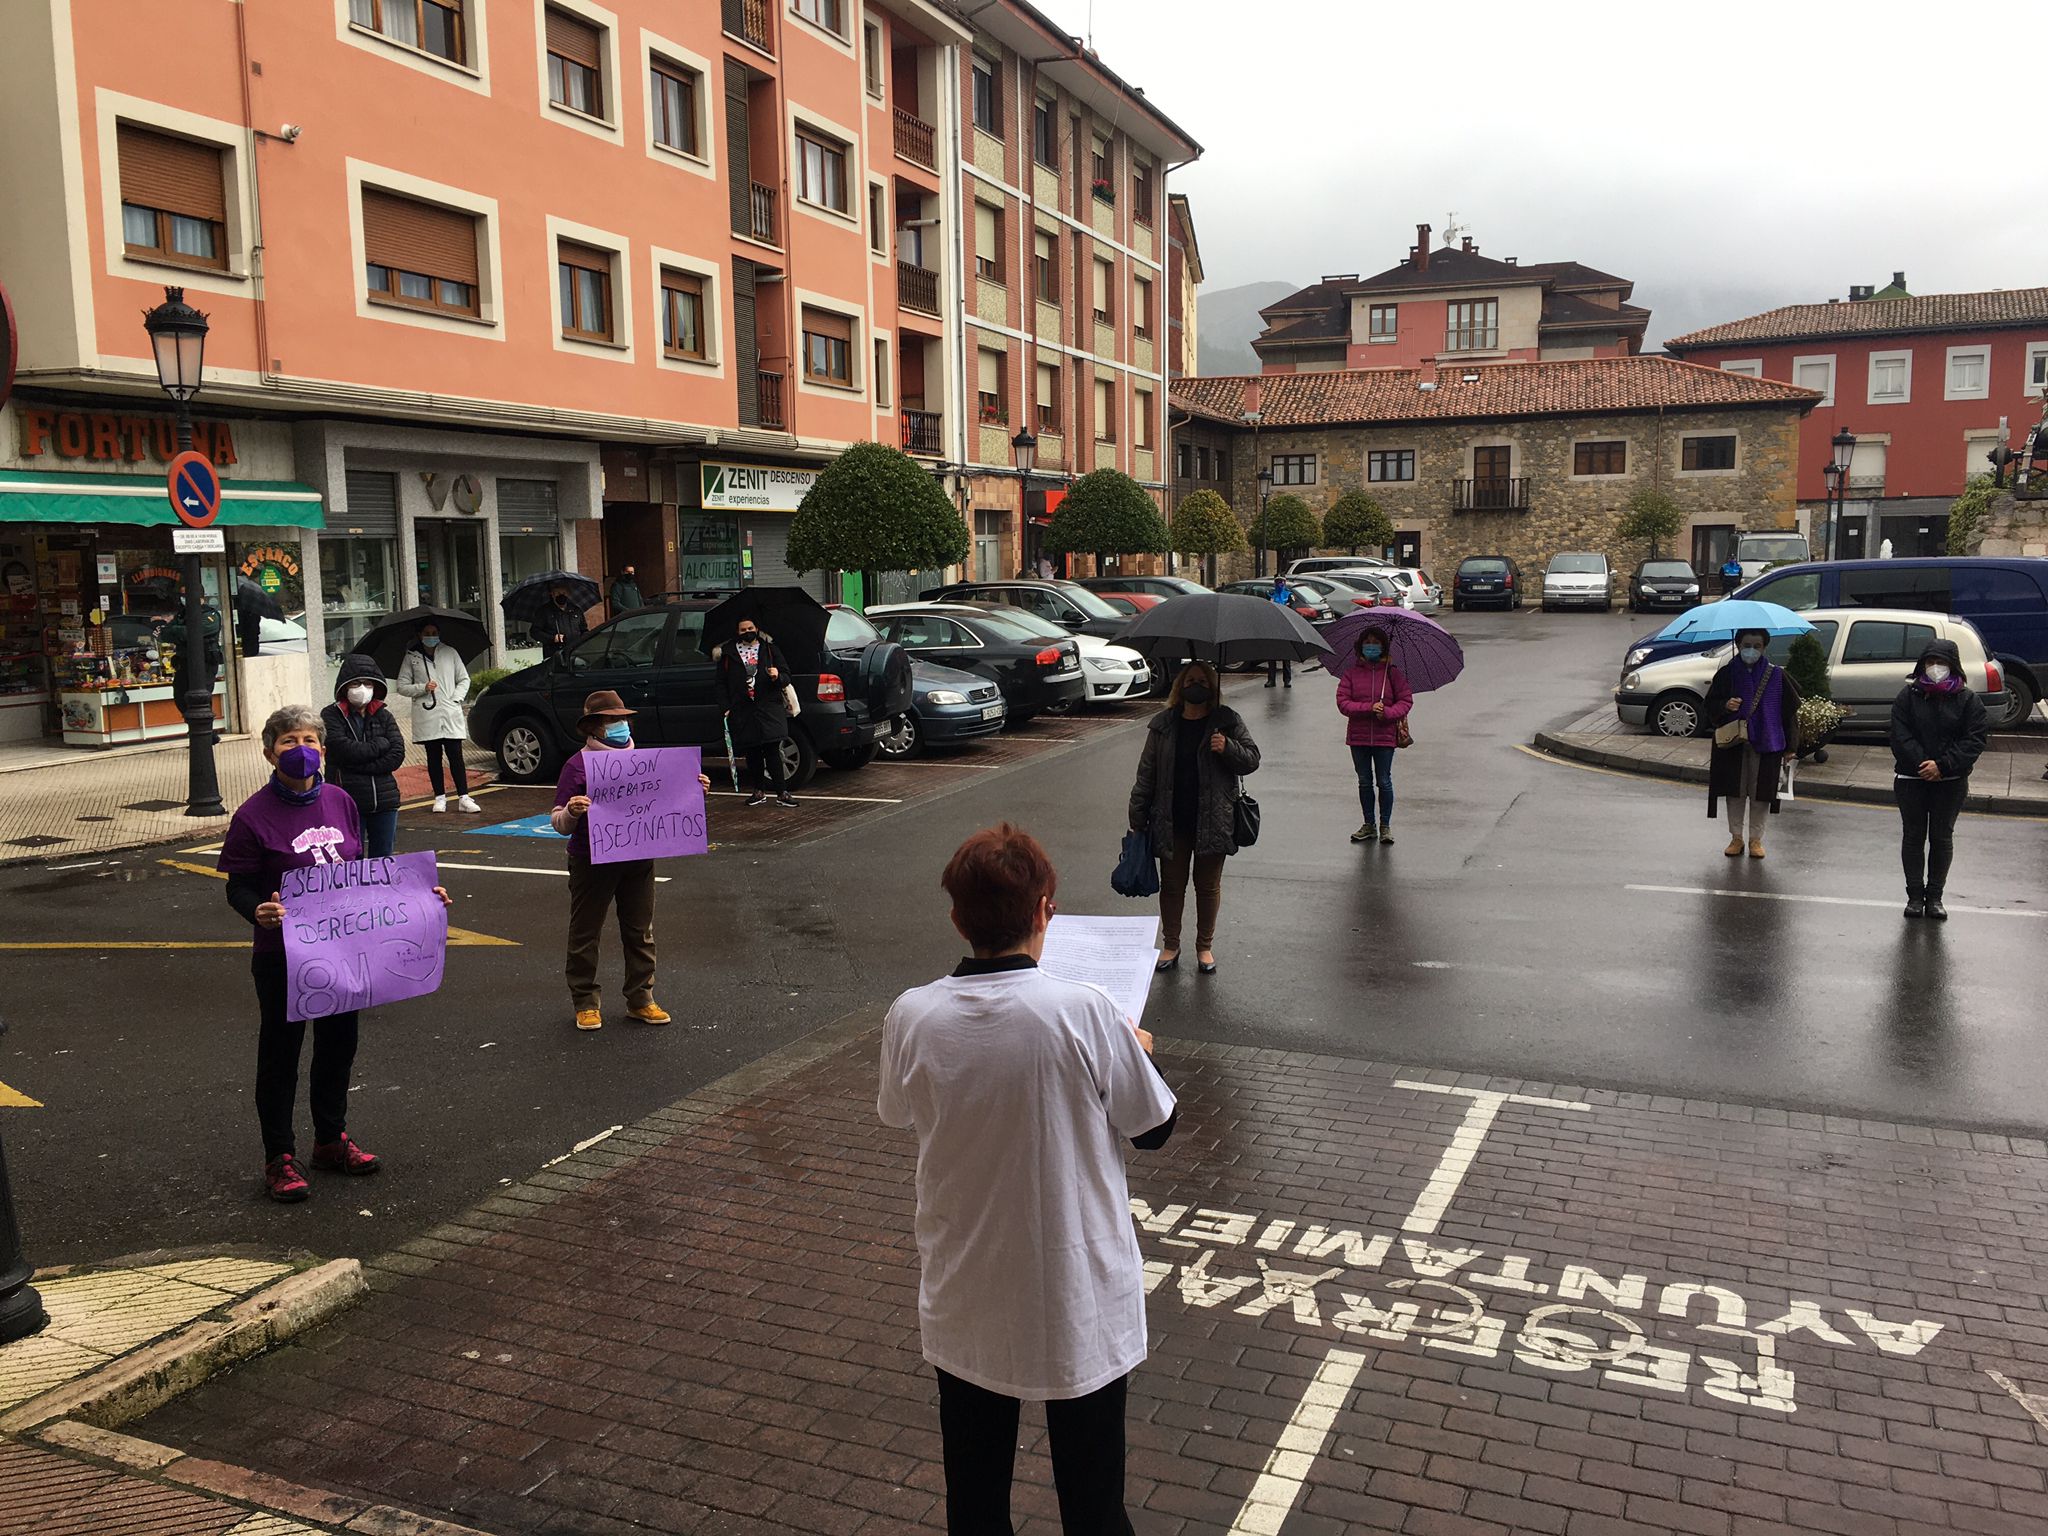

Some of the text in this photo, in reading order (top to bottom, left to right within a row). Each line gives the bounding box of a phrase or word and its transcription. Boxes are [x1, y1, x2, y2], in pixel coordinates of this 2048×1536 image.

[24, 409, 238, 465] FORTUNA
[728, 467, 768, 490] ZENIT
[770, 470, 811, 485] DESCENSO
[728, 494, 770, 506] experiencias
[241, 547, 299, 576] ESTANCO
[684, 561, 738, 580] ALQUILER
[592, 749, 662, 782] NO SON
[625, 799, 657, 817] SON
[279, 856, 395, 902] ESENCIALES
[294, 902, 410, 945] DERECHOS
[296, 952, 373, 1021] 8M
[1129, 1198, 1945, 1356] AYUNTAMIEN
[1143, 1258, 1798, 1413] RESERVA
